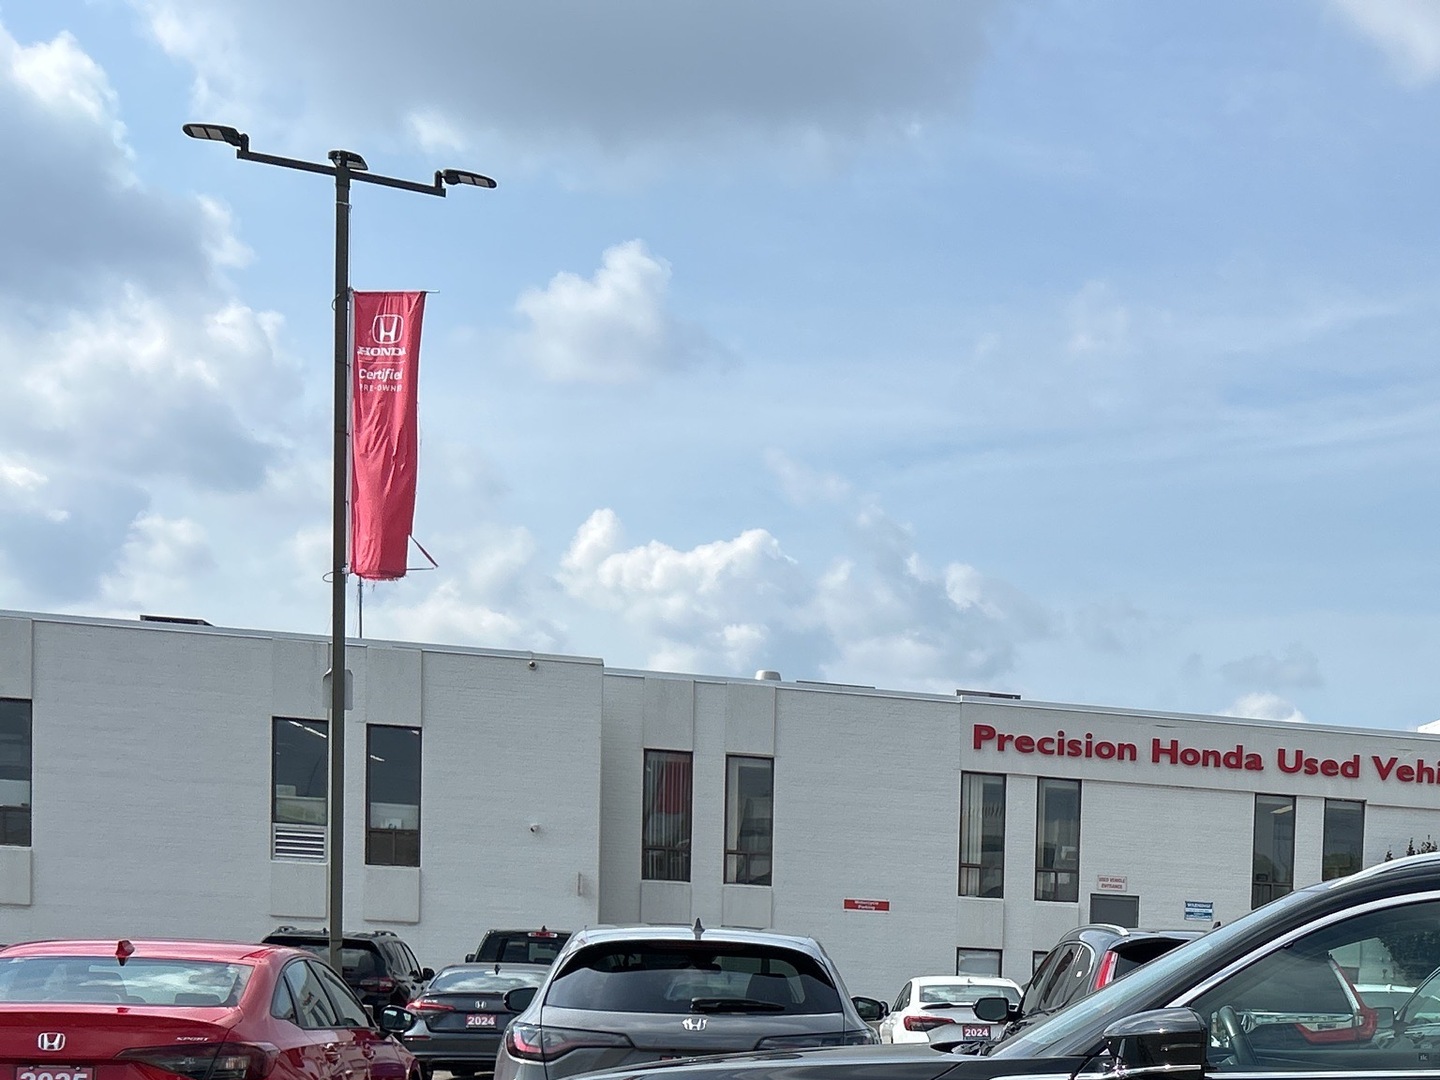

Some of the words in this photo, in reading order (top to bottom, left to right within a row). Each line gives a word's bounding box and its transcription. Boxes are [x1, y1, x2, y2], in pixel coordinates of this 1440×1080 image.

[973, 723, 1138, 761] Precision
[1151, 738, 1264, 771] Honda
[1277, 748, 1361, 779] Used
[467, 1016, 495, 1026] 2024
[964, 1028, 989, 1037] 2024
